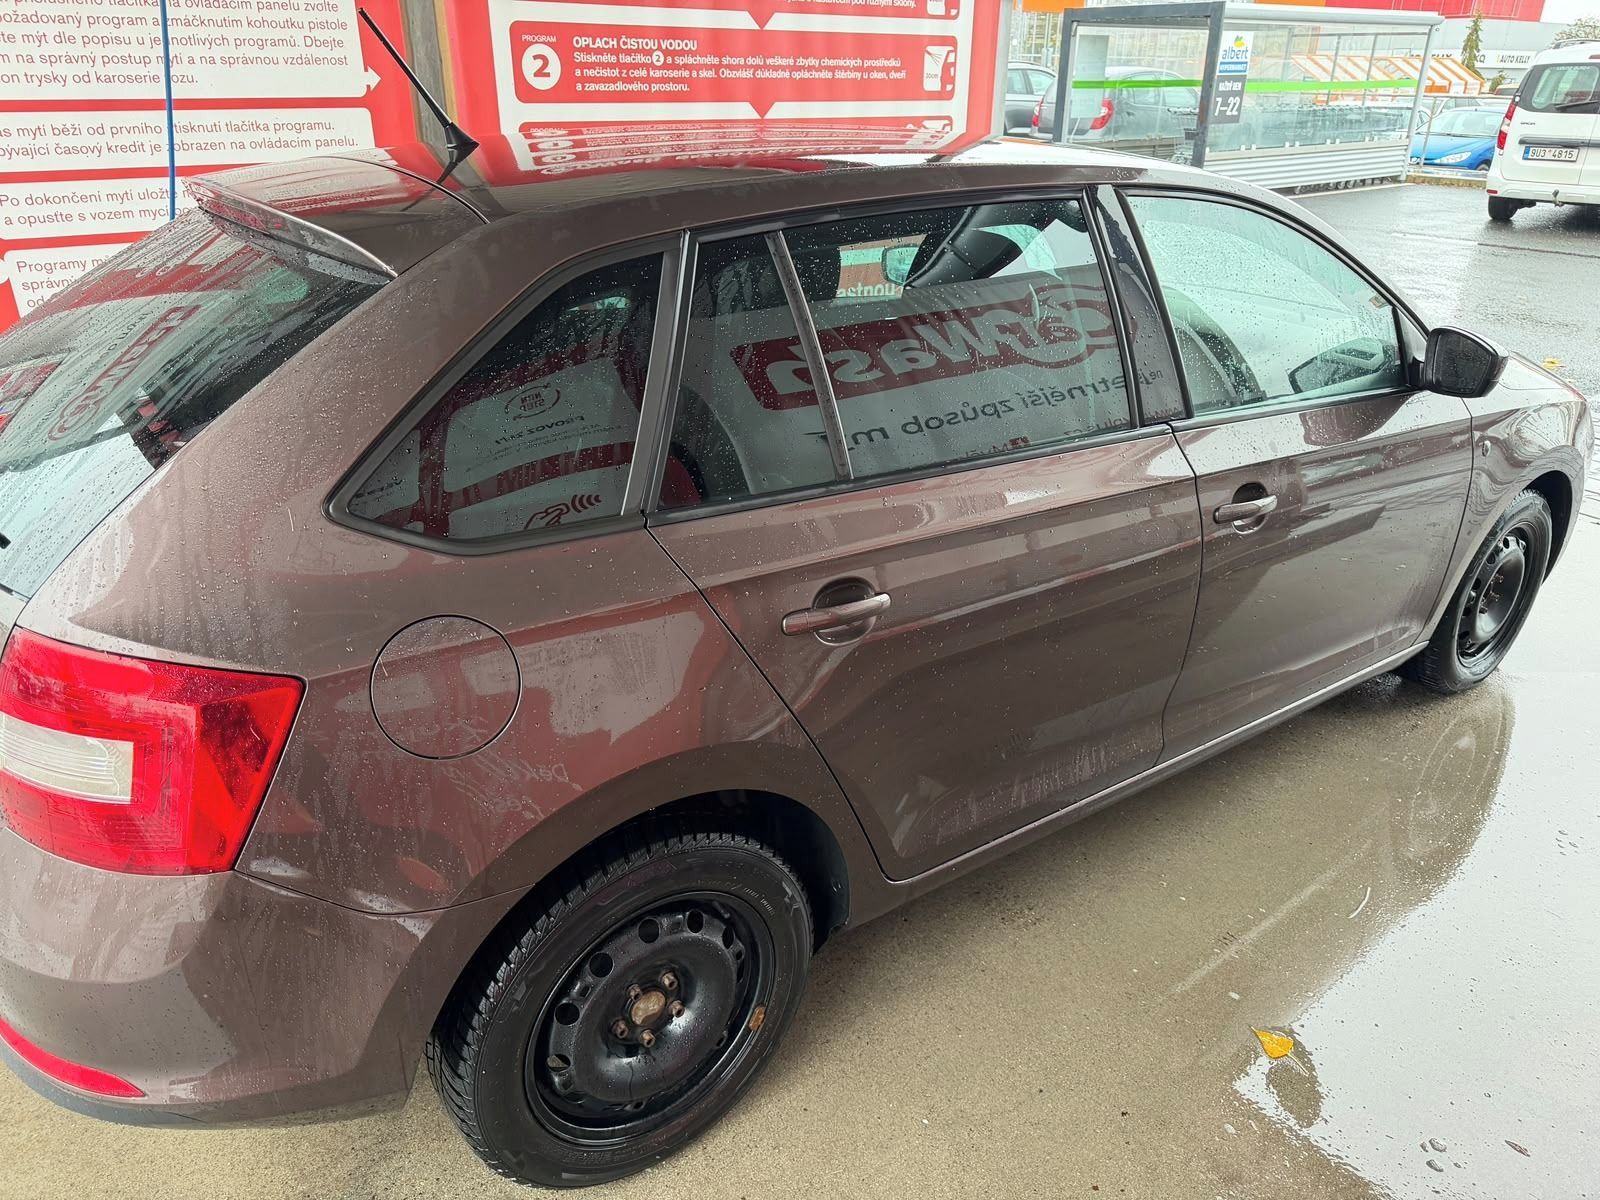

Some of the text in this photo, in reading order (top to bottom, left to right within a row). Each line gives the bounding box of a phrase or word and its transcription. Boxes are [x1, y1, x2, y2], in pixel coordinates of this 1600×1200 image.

[0, 10, 82, 28] ožadovaný
[86, 14, 148, 29] program
[152, 16, 160, 27] a
[246, 16, 304, 30] kohoutku
[308, 19, 348, 32] pistole
[0, 31, 344, 51] te mýt dle popisu u jenotlivých programů. Dbejte
[521, 34, 557, 43] PROGRAM
[573, 35, 697, 51] OPLACH ČISTOU VODOU
[16, 53, 34, 64] na
[39, 52, 96, 67] správný
[102, 53, 151, 68] postup
[187, 56, 195, 66] a
[199, 56, 216, 66] na
[220, 54, 279, 68] správnou
[282, 53, 348, 66] vzdálenost
[573, 52, 617, 63] Stiskněte
[619, 52, 651, 64] tlačítko
[666, 56, 672, 64] a
[675, 54, 720, 66] spláchněte
[721, 55, 744, 66] shora
[746, 55, 763, 65] dolů
[765, 55, 794, 66] veškeré
[796, 56, 819, 67] zbytky
[820, 56, 862, 68] chemických
[1222, 46, 1248, 60] albert
[1500, 55, 1531, 64] AUTO KELLY
[532, 54, 551, 78] 2
[583, 67, 620, 78] nečistot
[629, 67, 647, 77] celé
[649, 67, 690, 78] karoserie
[698, 67, 717, 78] skel.
[792, 69, 833, 80] opláchněte
[863, 71, 868, 79] u
[0, 71, 198, 87] on trysky od karoserie ozu.
[576, 81, 690, 93] a zavazadlového prostoru.
[17, 124, 47, 140] mytí
[51, 123, 82, 136] běží
[87, 123, 105, 136] od
[111, 122, 162, 138] prvního
[168, 120, 221, 134] tisknutí
[225, 120, 269, 133] tlačítka
[273, 119, 335, 134] programu.
[55, 142, 102, 158] časový
[106, 140, 145, 155] kredit
[149, 140, 162, 155] je
[167, 139, 226, 152] obrazen
[230, 141, 246, 150] na
[249, 137, 311, 149] ovládacím
[315, 135, 359, 150] panelu.
[1531, 148, 1575, 159] 9U3 4815
[1, 194, 20, 207] Po
[25, 190, 101, 206] dokončení
[106, 189, 133, 205] mytí
[4, 215, 13, 226] a
[17, 211, 74, 228] opusťte
[78, 212, 86, 222] s
[90, 209, 134, 221] vozem
[16, 260, 87, 275] Programy
[21, 275, 77, 293] správn
